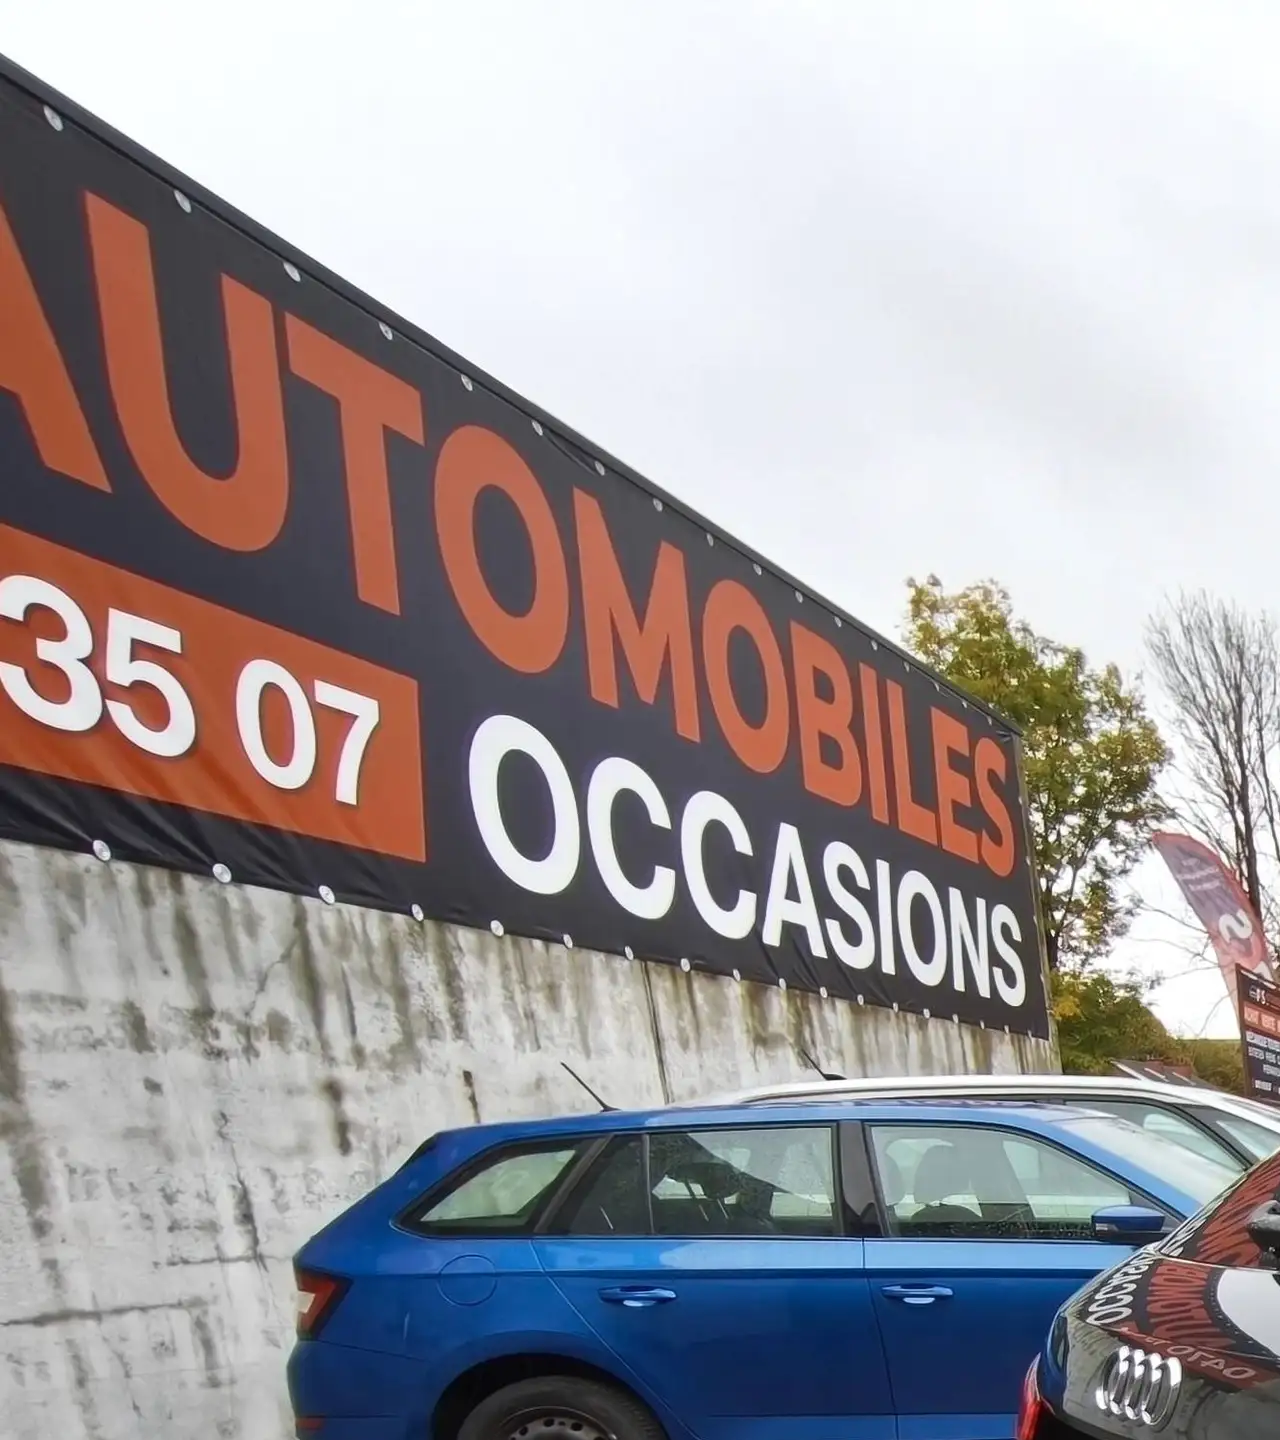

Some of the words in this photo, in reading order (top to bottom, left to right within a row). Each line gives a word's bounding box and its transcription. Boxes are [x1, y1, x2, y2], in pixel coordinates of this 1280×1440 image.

[0, 574, 197, 759] 35
[234, 658, 381, 806] 07
[467, 714, 1026, 1007] OCCASIONS
